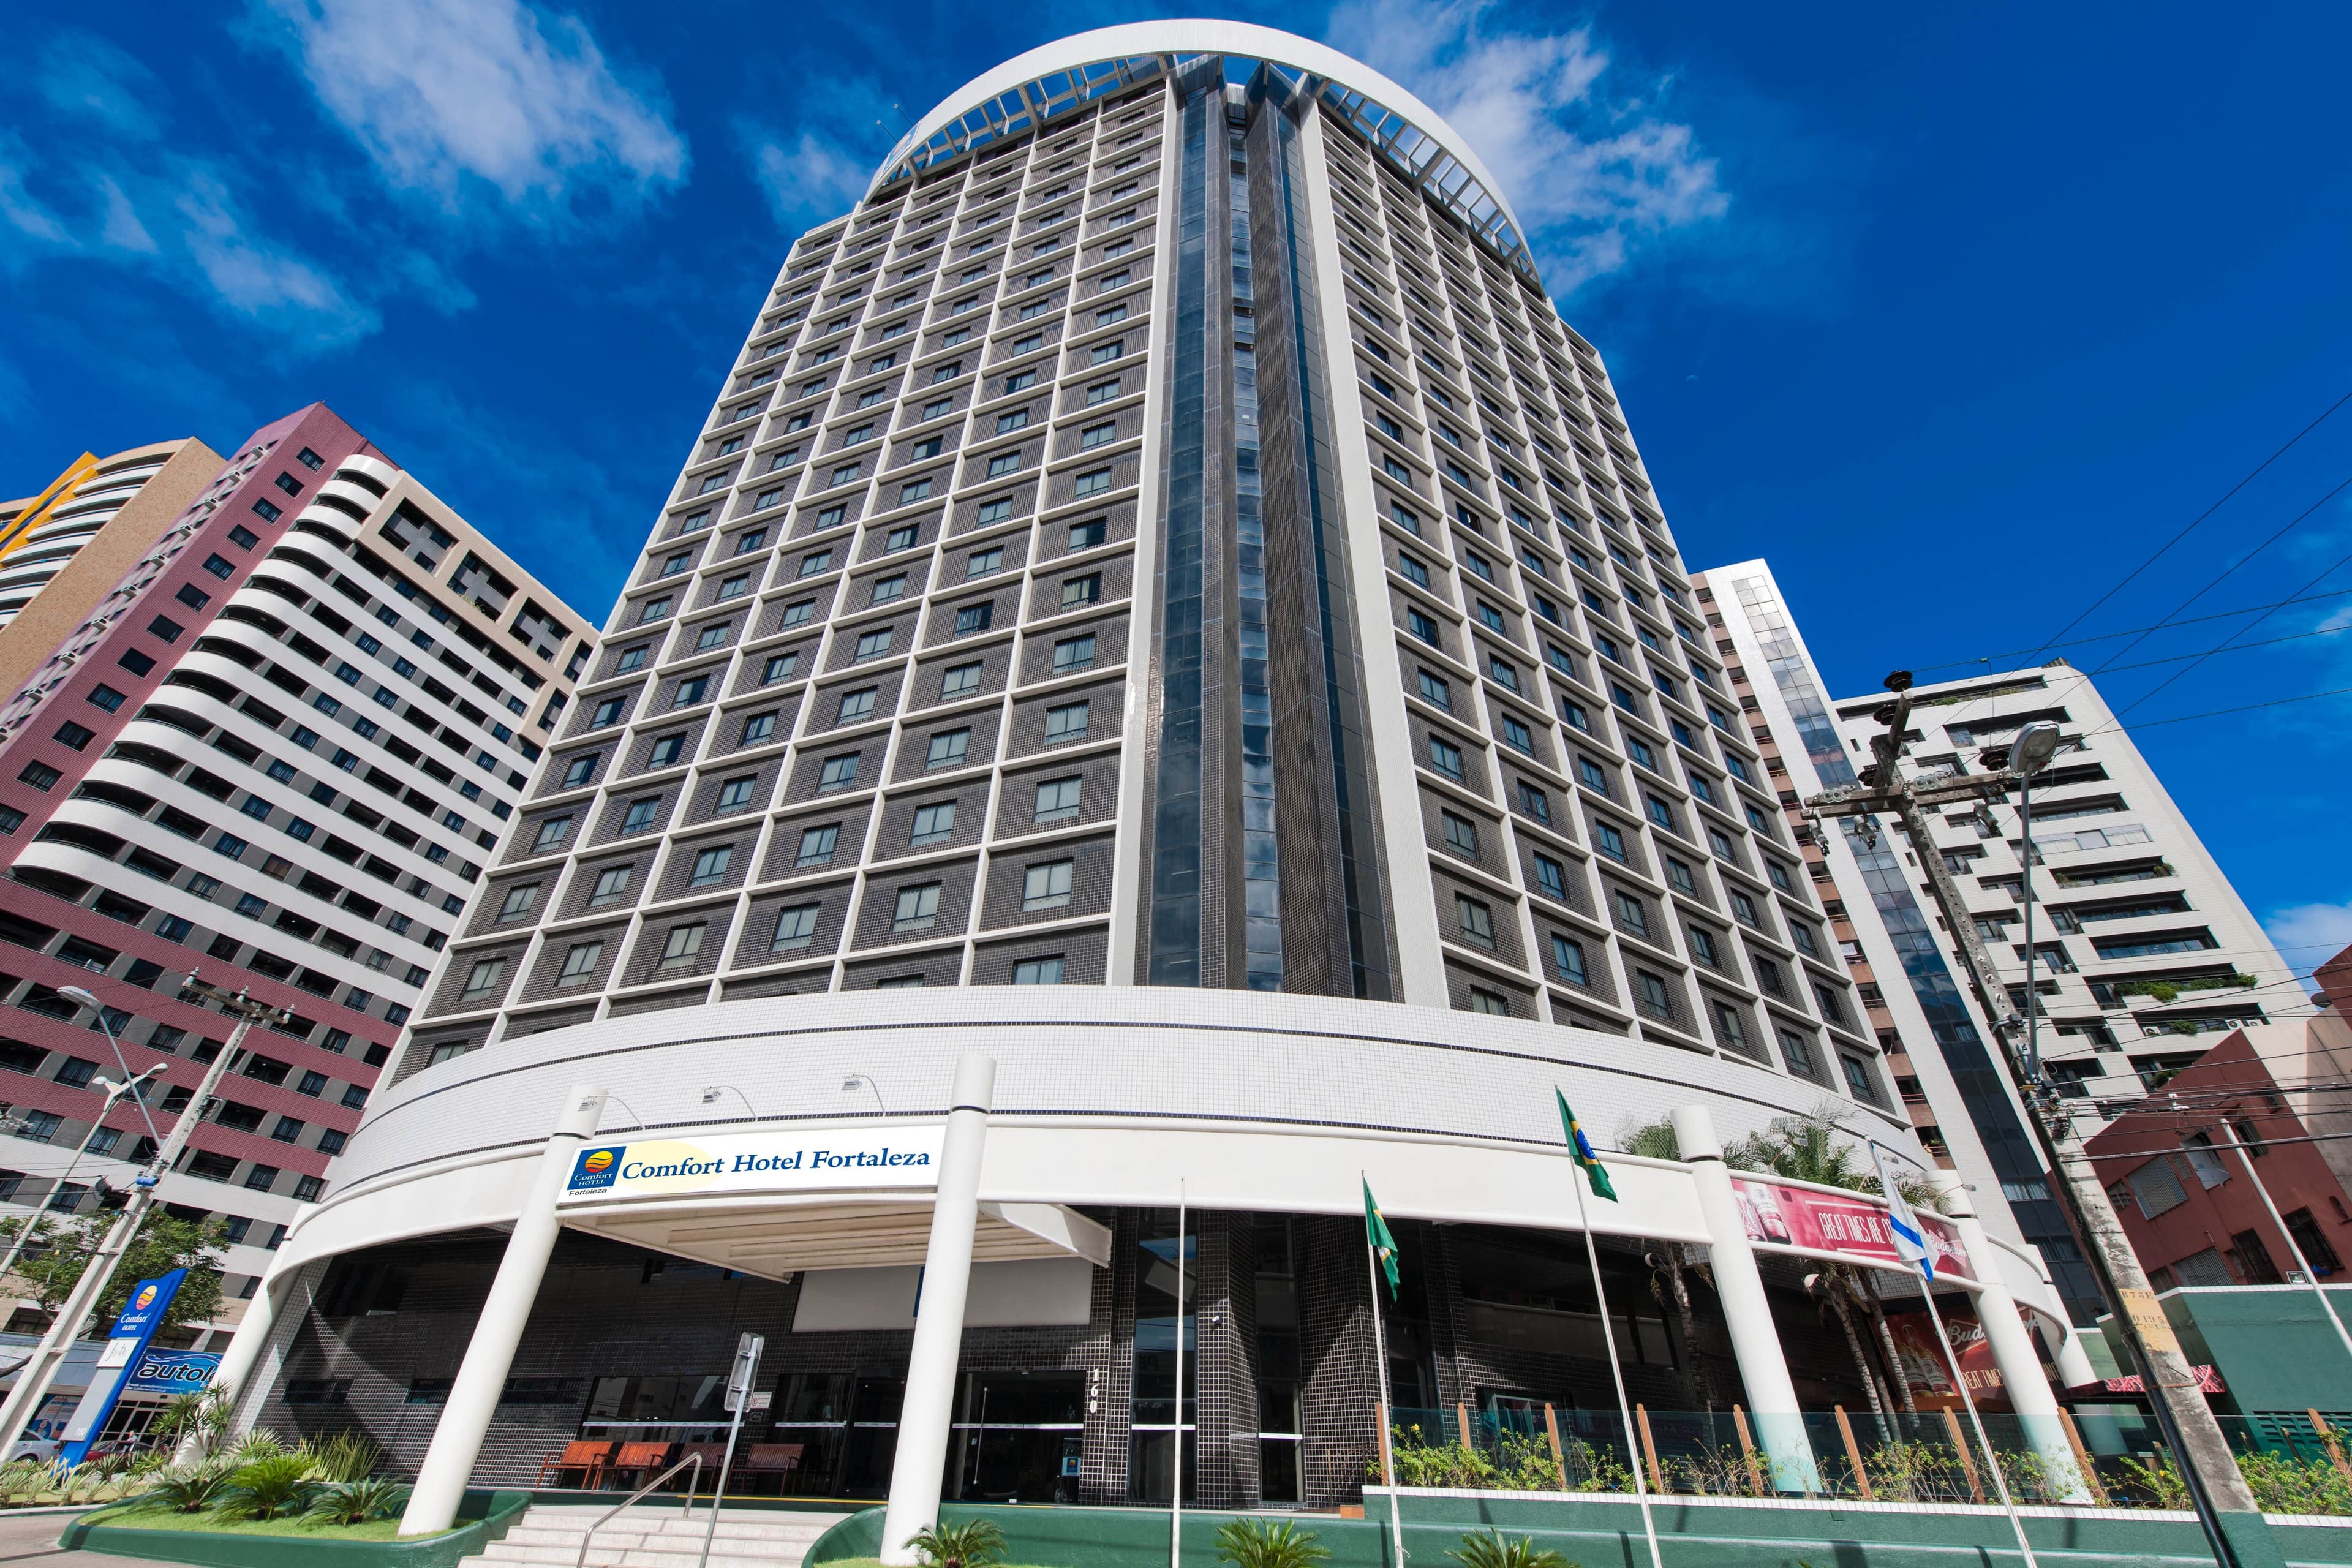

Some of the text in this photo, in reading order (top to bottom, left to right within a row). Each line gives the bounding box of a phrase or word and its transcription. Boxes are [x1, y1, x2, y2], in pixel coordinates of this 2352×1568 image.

[622, 1148, 930, 1180] Comfort Hotel Fortaleza
[575, 1172, 613, 1182] Comfort
[1818, 1212, 1847, 1240] GREAT
[1842, 1215, 1871, 1243] TIMES
[1866, 1216, 1886, 1244] ARE
[121, 1313, 148, 1323] Comfort
[1090, 1368, 1099, 1414] 160
[1961, 1371, 1983, 1390] REAT
